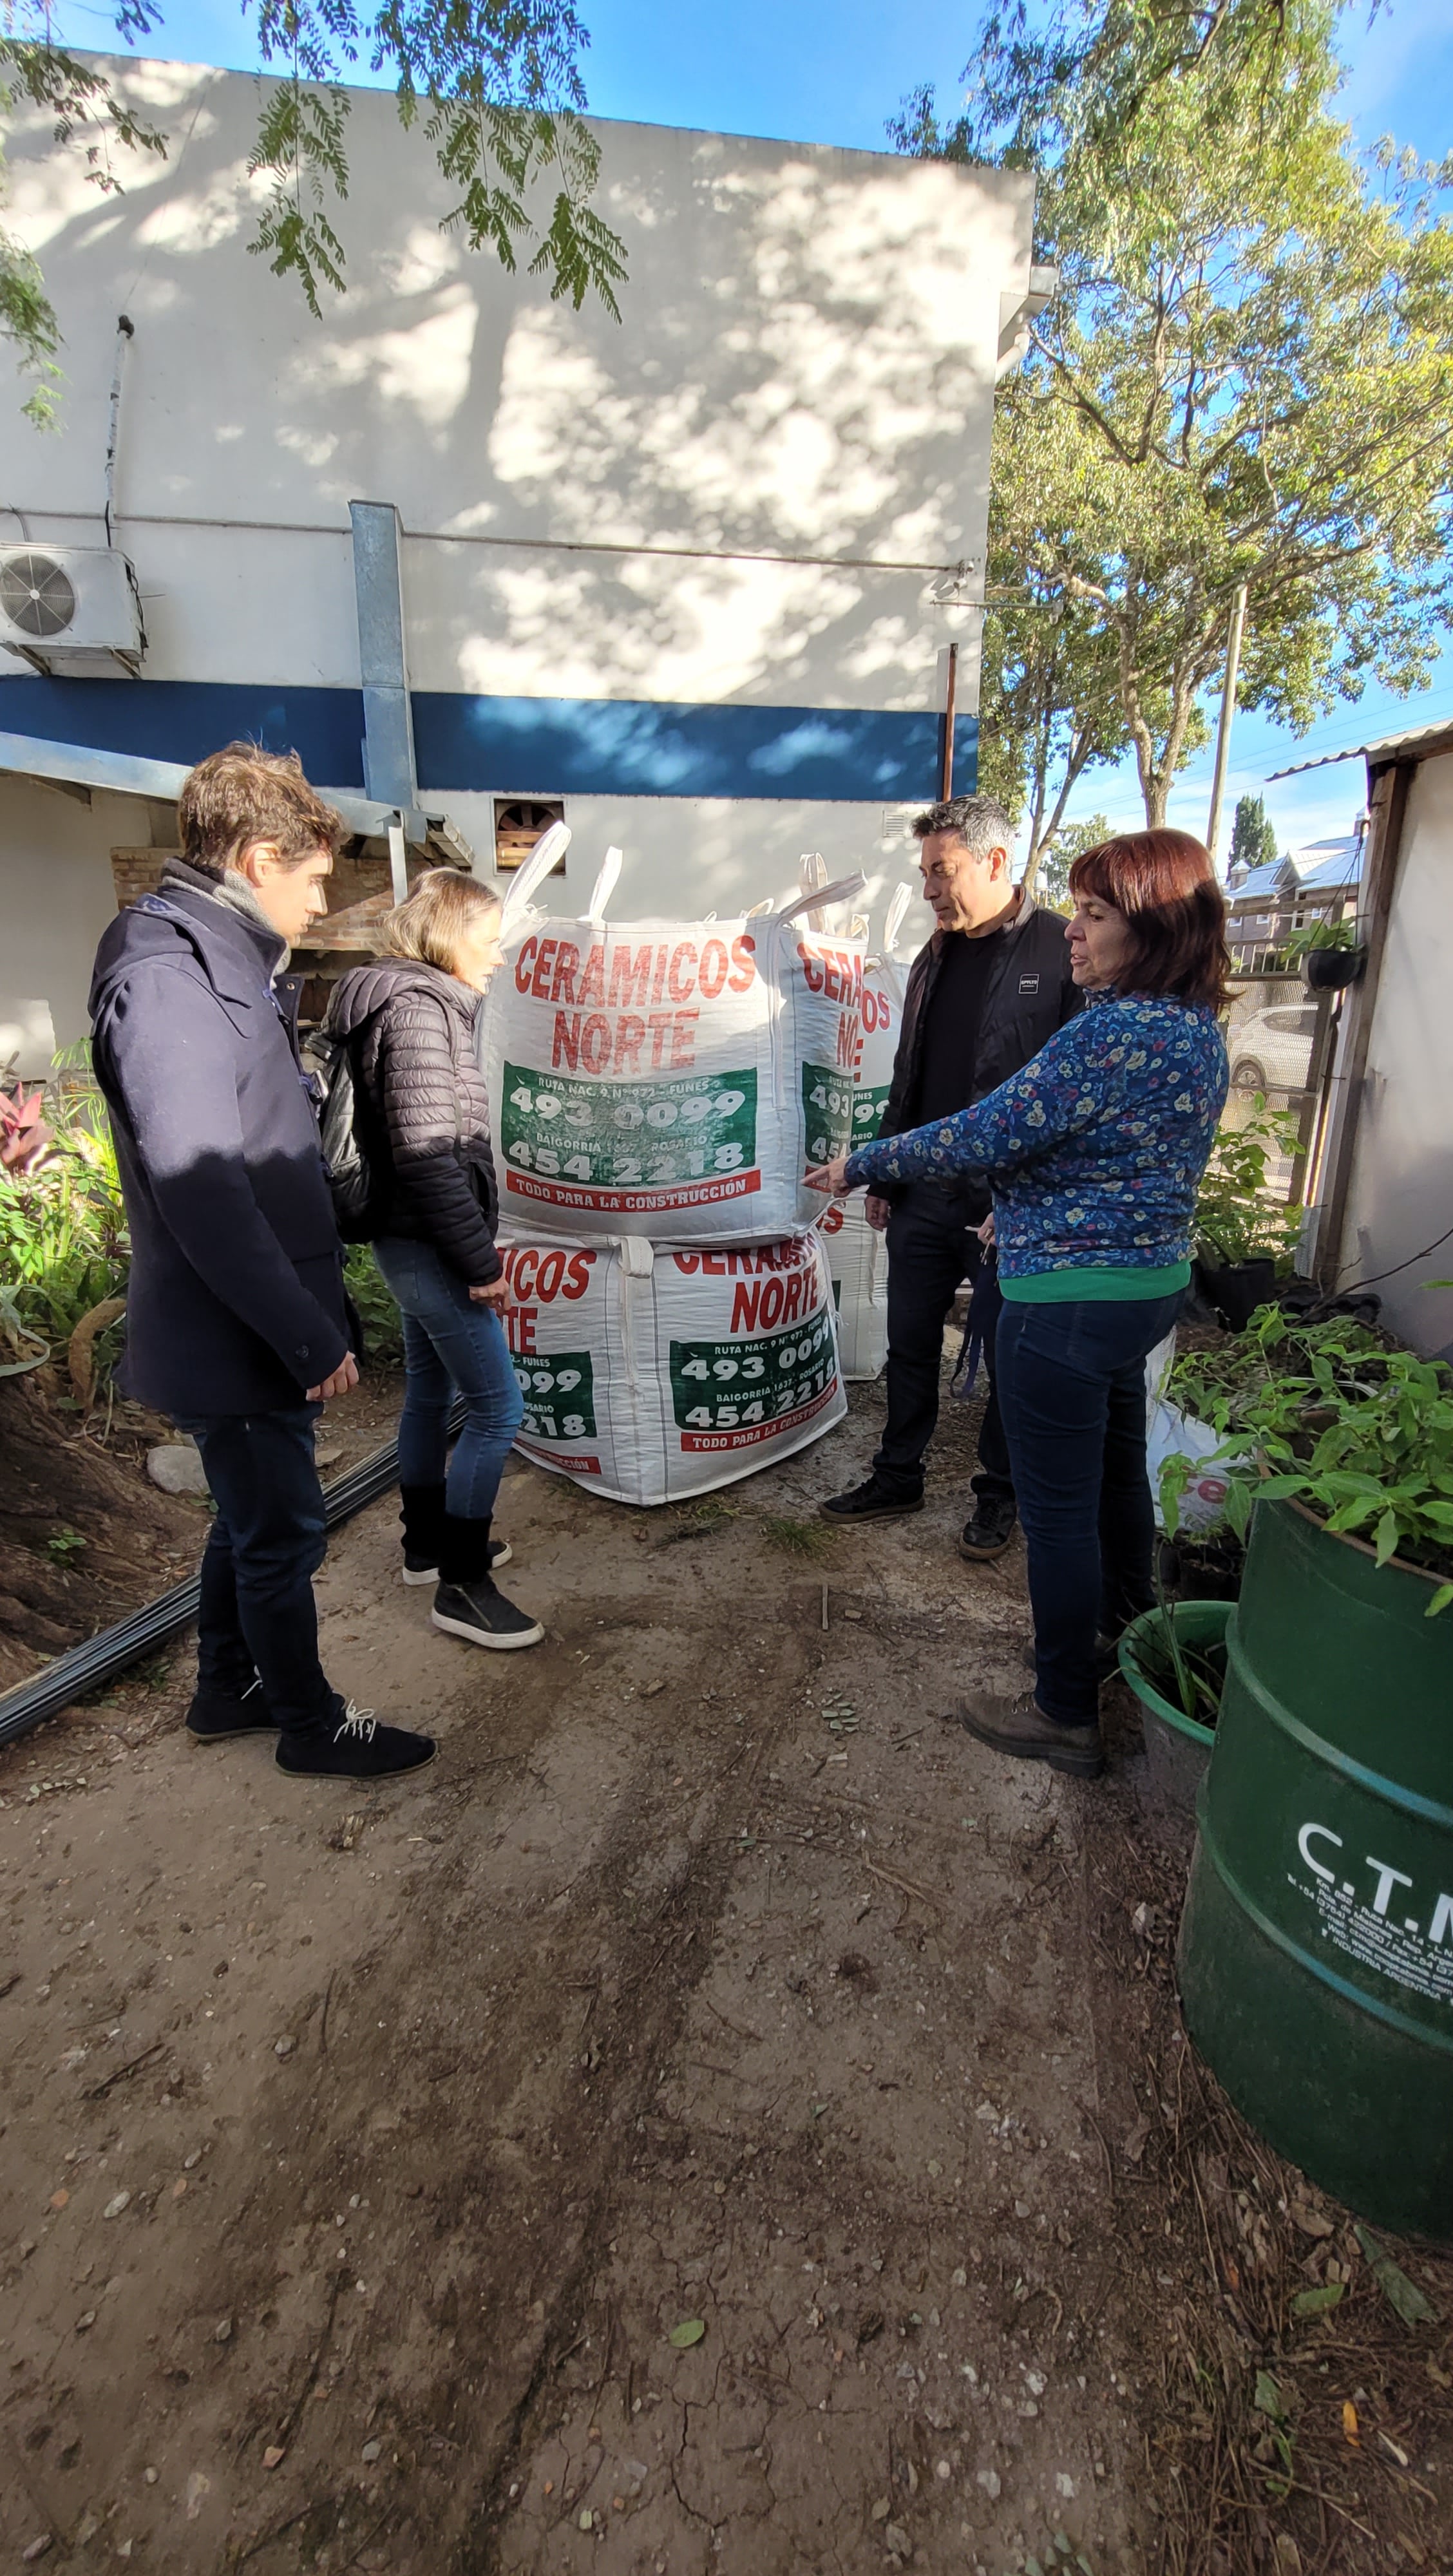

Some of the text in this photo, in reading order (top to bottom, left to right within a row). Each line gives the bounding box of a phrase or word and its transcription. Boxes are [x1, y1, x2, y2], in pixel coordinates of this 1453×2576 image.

[515, 934, 756, 1008] CERAMICOS
[550, 1006, 700, 1075] NORTE
[538, 1076, 564, 1092] RUTA
[669, 1079, 709, 1093] FUNES
[810, 1084, 850, 1118] 493
[510, 1086, 745, 1129] 493 0099
[536, 1132, 602, 1153] BAIGORRIA
[651, 1135, 707, 1152] ROSARIO
[509, 1141, 745, 1182] 454 2218
[517, 1179, 746, 1209] TODO PARA LA CONSTRUCCIÓN
[730, 1259, 817, 1333] NORTE
[681, 1316, 829, 1381] 493 0099
[715, 1346, 741, 1355] RUTA
[745, 1343, 767, 1352] NAC.
[771, 1340, 776, 1348] 9
[790, 1330, 803, 1341] 972
[514, 1368, 582, 1393] 099
[523, 1357, 551, 1367] FUNES
[716, 1386, 771, 1402] BAIGORRIA
[774, 1379, 792, 1392] 1637
[799, 1358, 824, 1380] ROSARIO
[685, 1356, 833, 1427] 454 2218
[693, 1437, 728, 1448] TODO
[733, 1432, 761, 1445] PARA
[764, 1425, 777, 1436] LA
[1316, 1878, 1330, 1892] Km.
[1361, 1906, 1383, 1924] Ruta
[1385, 1920, 1405, 1937] Nac.
[1412, 1935, 1424, 1945] 14
[1319, 1908, 1347, 1930] E-mail:
[1319, 1889, 1336, 1906] Pcia.
[1340, 1904, 1351, 1914] de
[1354, 1911, 1392, 1940] Misiones
[1403, 1940, 1422, 1956] Rep.
[1327, 1922, 1349, 1940] Web:
[1348, 1917, 1384, 1944] 422000
[1333, 1937, 1441, 2000] INDUSTRIA ARGENTINA
